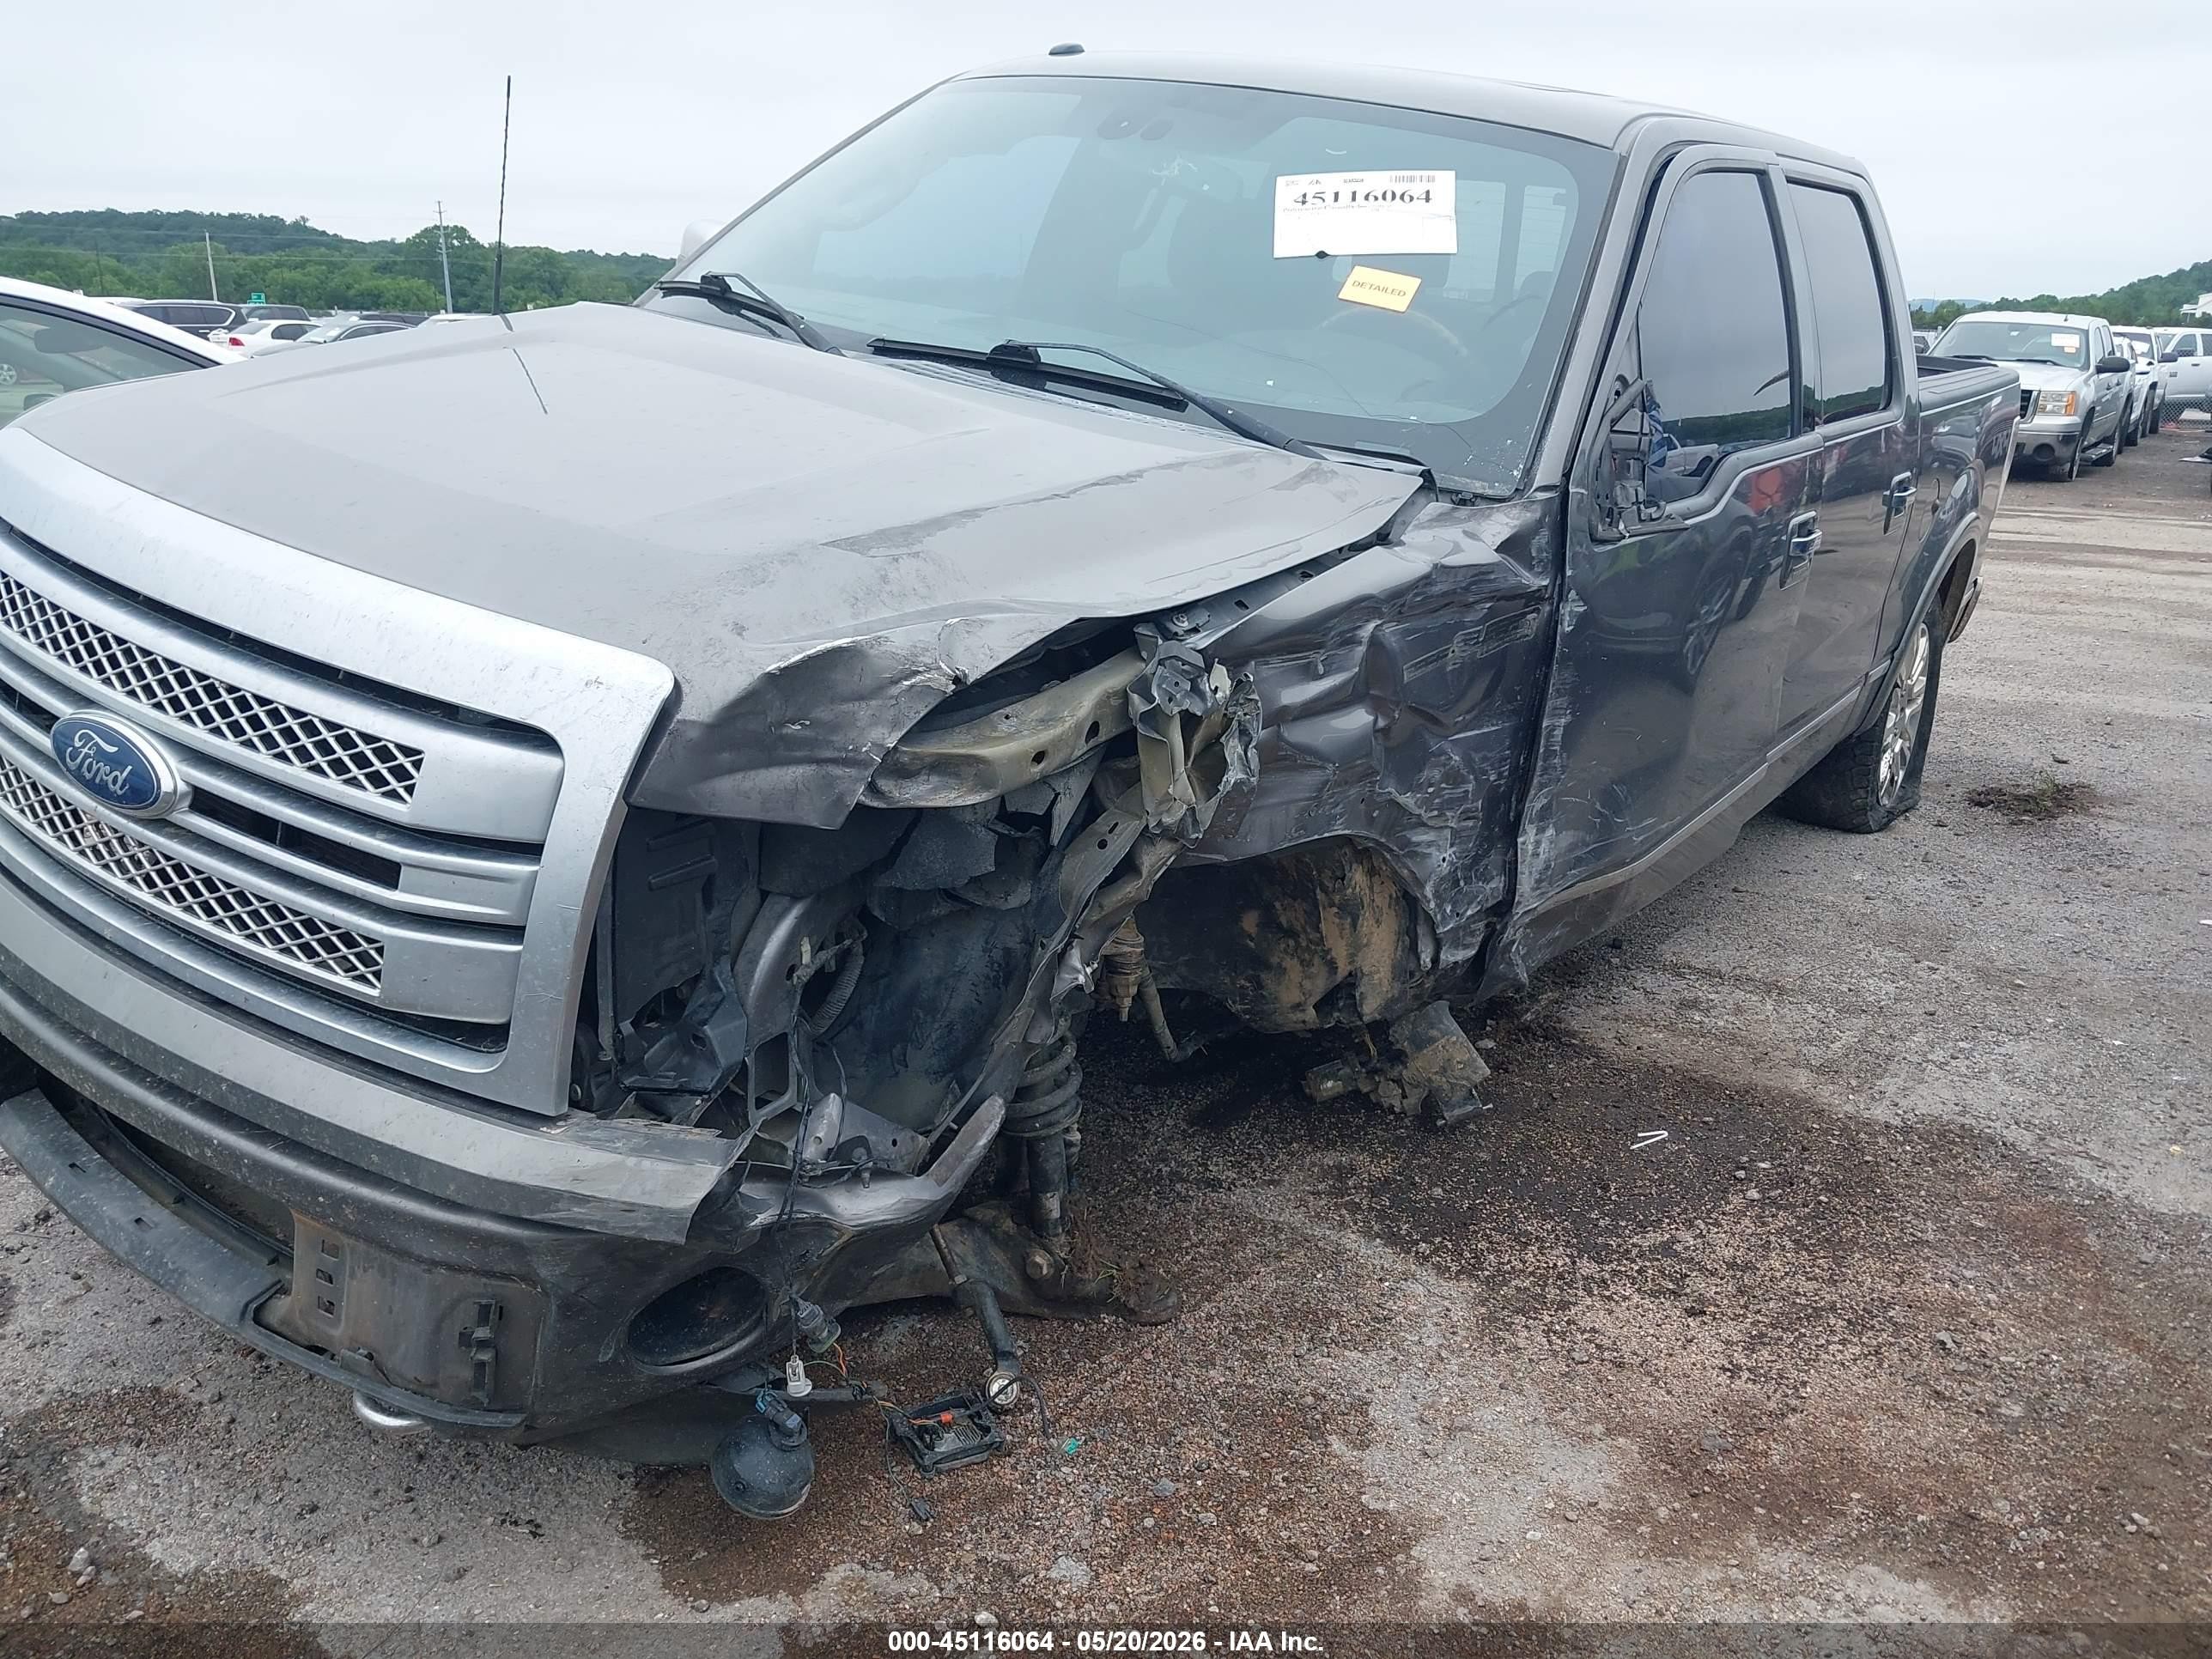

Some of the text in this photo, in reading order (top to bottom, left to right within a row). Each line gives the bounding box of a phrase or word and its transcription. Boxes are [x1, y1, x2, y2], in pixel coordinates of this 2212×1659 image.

[1293, 189, 1432, 205] 45116064
[1352, 280, 1407, 297] DETAILED
[65, 729, 134, 796] Ford
